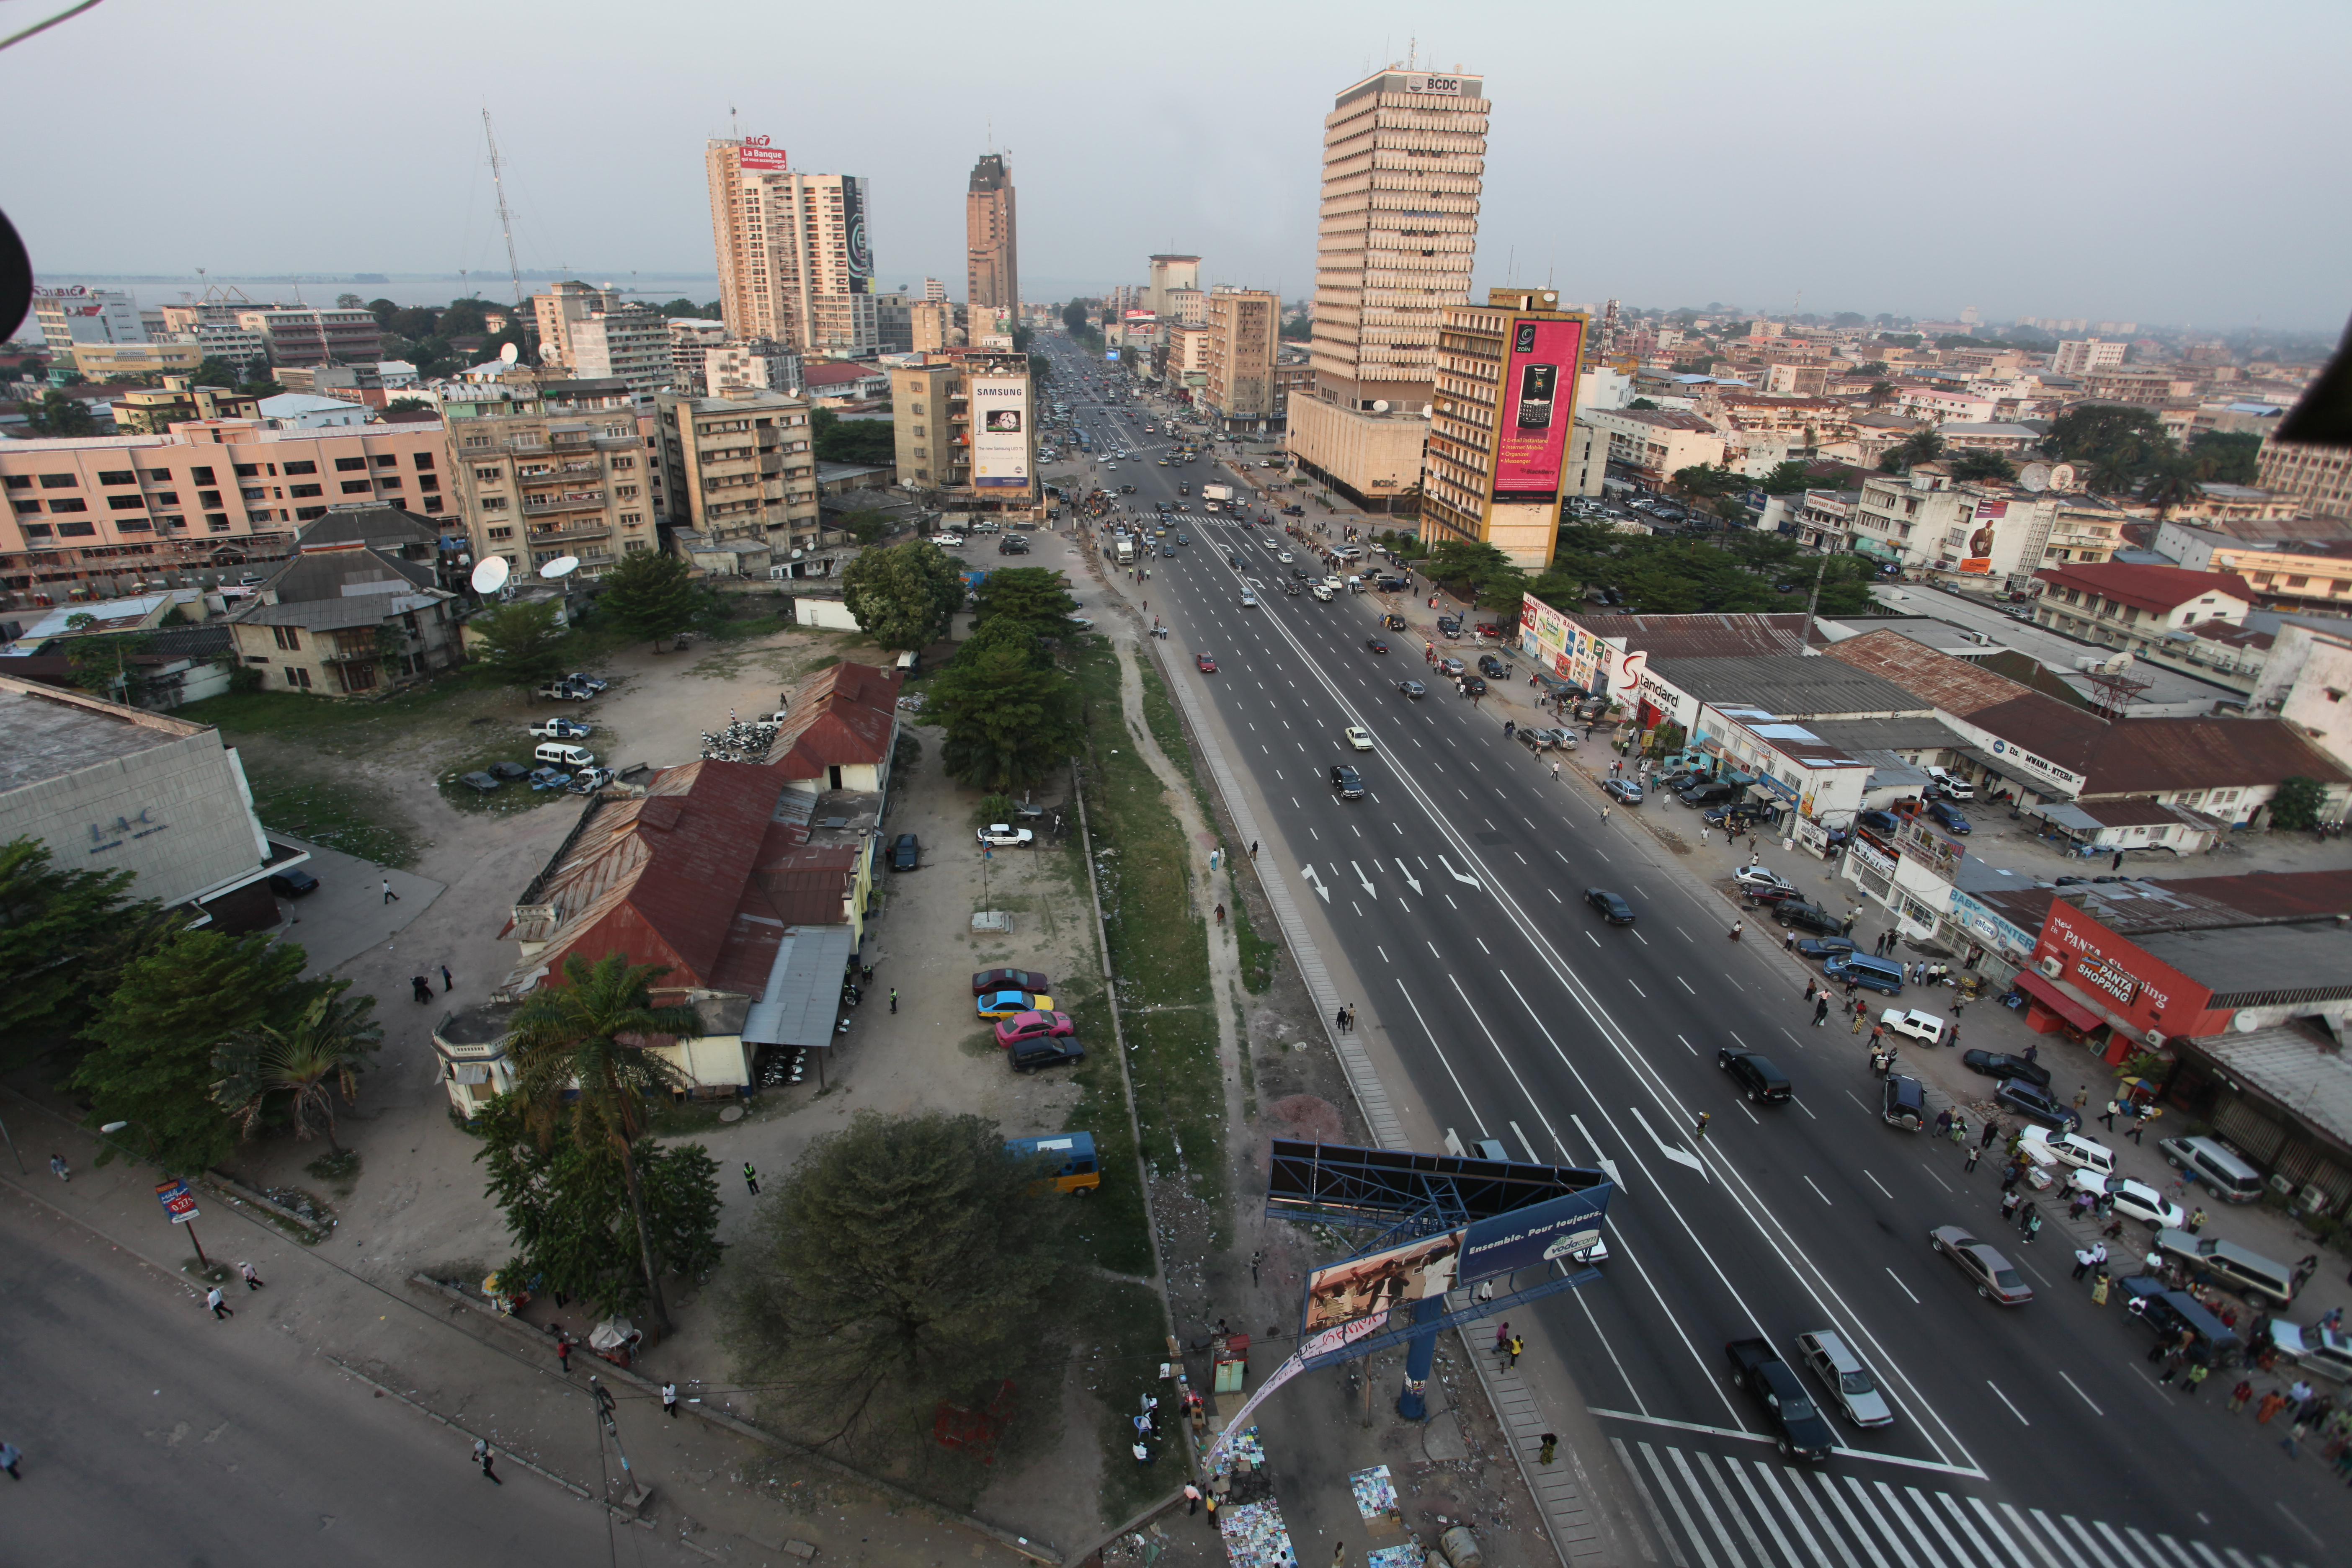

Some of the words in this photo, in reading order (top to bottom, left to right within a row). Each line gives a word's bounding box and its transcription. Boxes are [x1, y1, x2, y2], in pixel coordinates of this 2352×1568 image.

[1427, 78, 1457, 91] BCDC
[754, 150, 782, 159] Banque
[57, 288, 77, 297] BIC
[1809, 498, 1828, 508] ELEPHANT
[1527, 596, 1561, 623] ALIMENTATION
[2009, 746, 2019, 758] Ets.
[2025, 754, 2048, 771] MWANA
[2052, 766, 2073, 782] NTEBA
[1801, 825, 1820, 841] SOUZA
[1868, 834, 1889, 853] Oran
[1949, 888, 1980, 912] BABY
[1991, 916, 2035, 952] CENTER
[1975, 919, 1994, 936] chicco
[2054, 917, 2071, 929] New
[2063, 930, 2101, 957] PANTA
[2077, 963, 2129, 1003] SHOPPING
[2099, 965, 2132, 993] PANTA
[1468, 1234, 1524, 1255] Ensemble.
[1528, 1224, 1553, 1237] Pour
[1555, 1210, 1602, 1228] toujours.
[1551, 1235, 1596, 1254] vodacom
